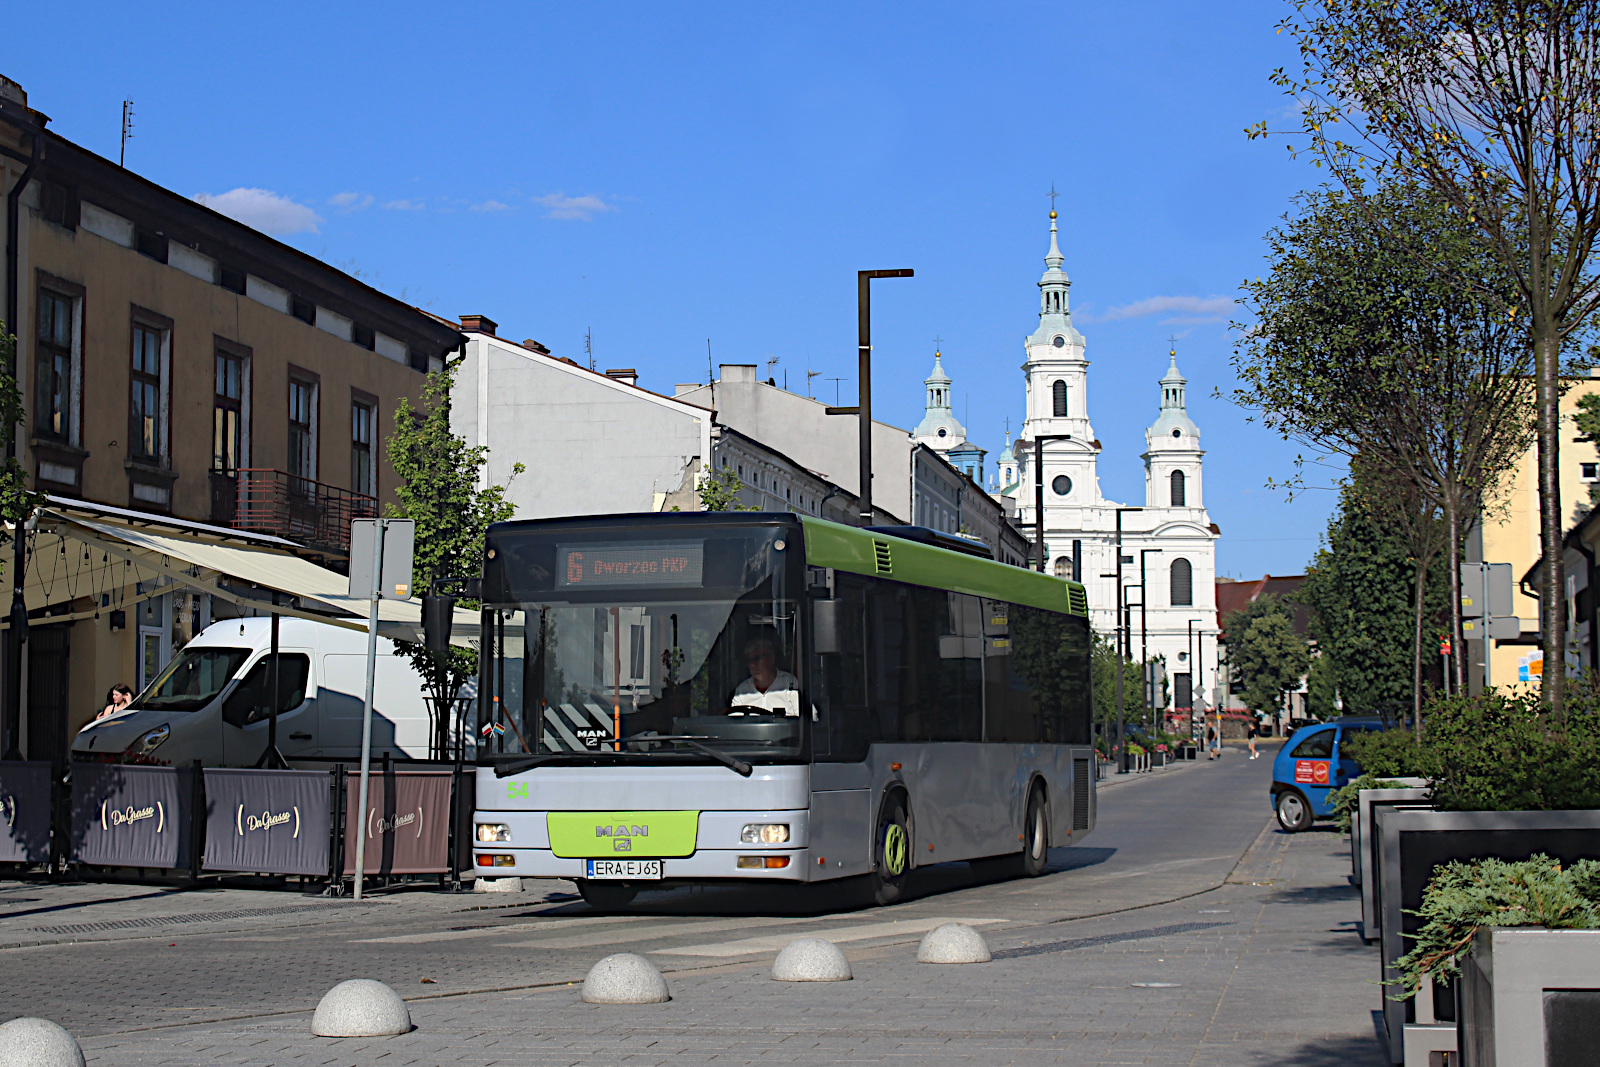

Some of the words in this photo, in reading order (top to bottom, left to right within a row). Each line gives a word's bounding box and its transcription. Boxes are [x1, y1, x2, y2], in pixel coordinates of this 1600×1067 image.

[567, 551, 583, 582] 6
[594, 560, 658, 574] Dworzec
[662, 557, 688, 573] PKP
[577, 730, 606, 738] MAN
[507, 782, 529, 799] 54
[596, 825, 648, 837] MAN
